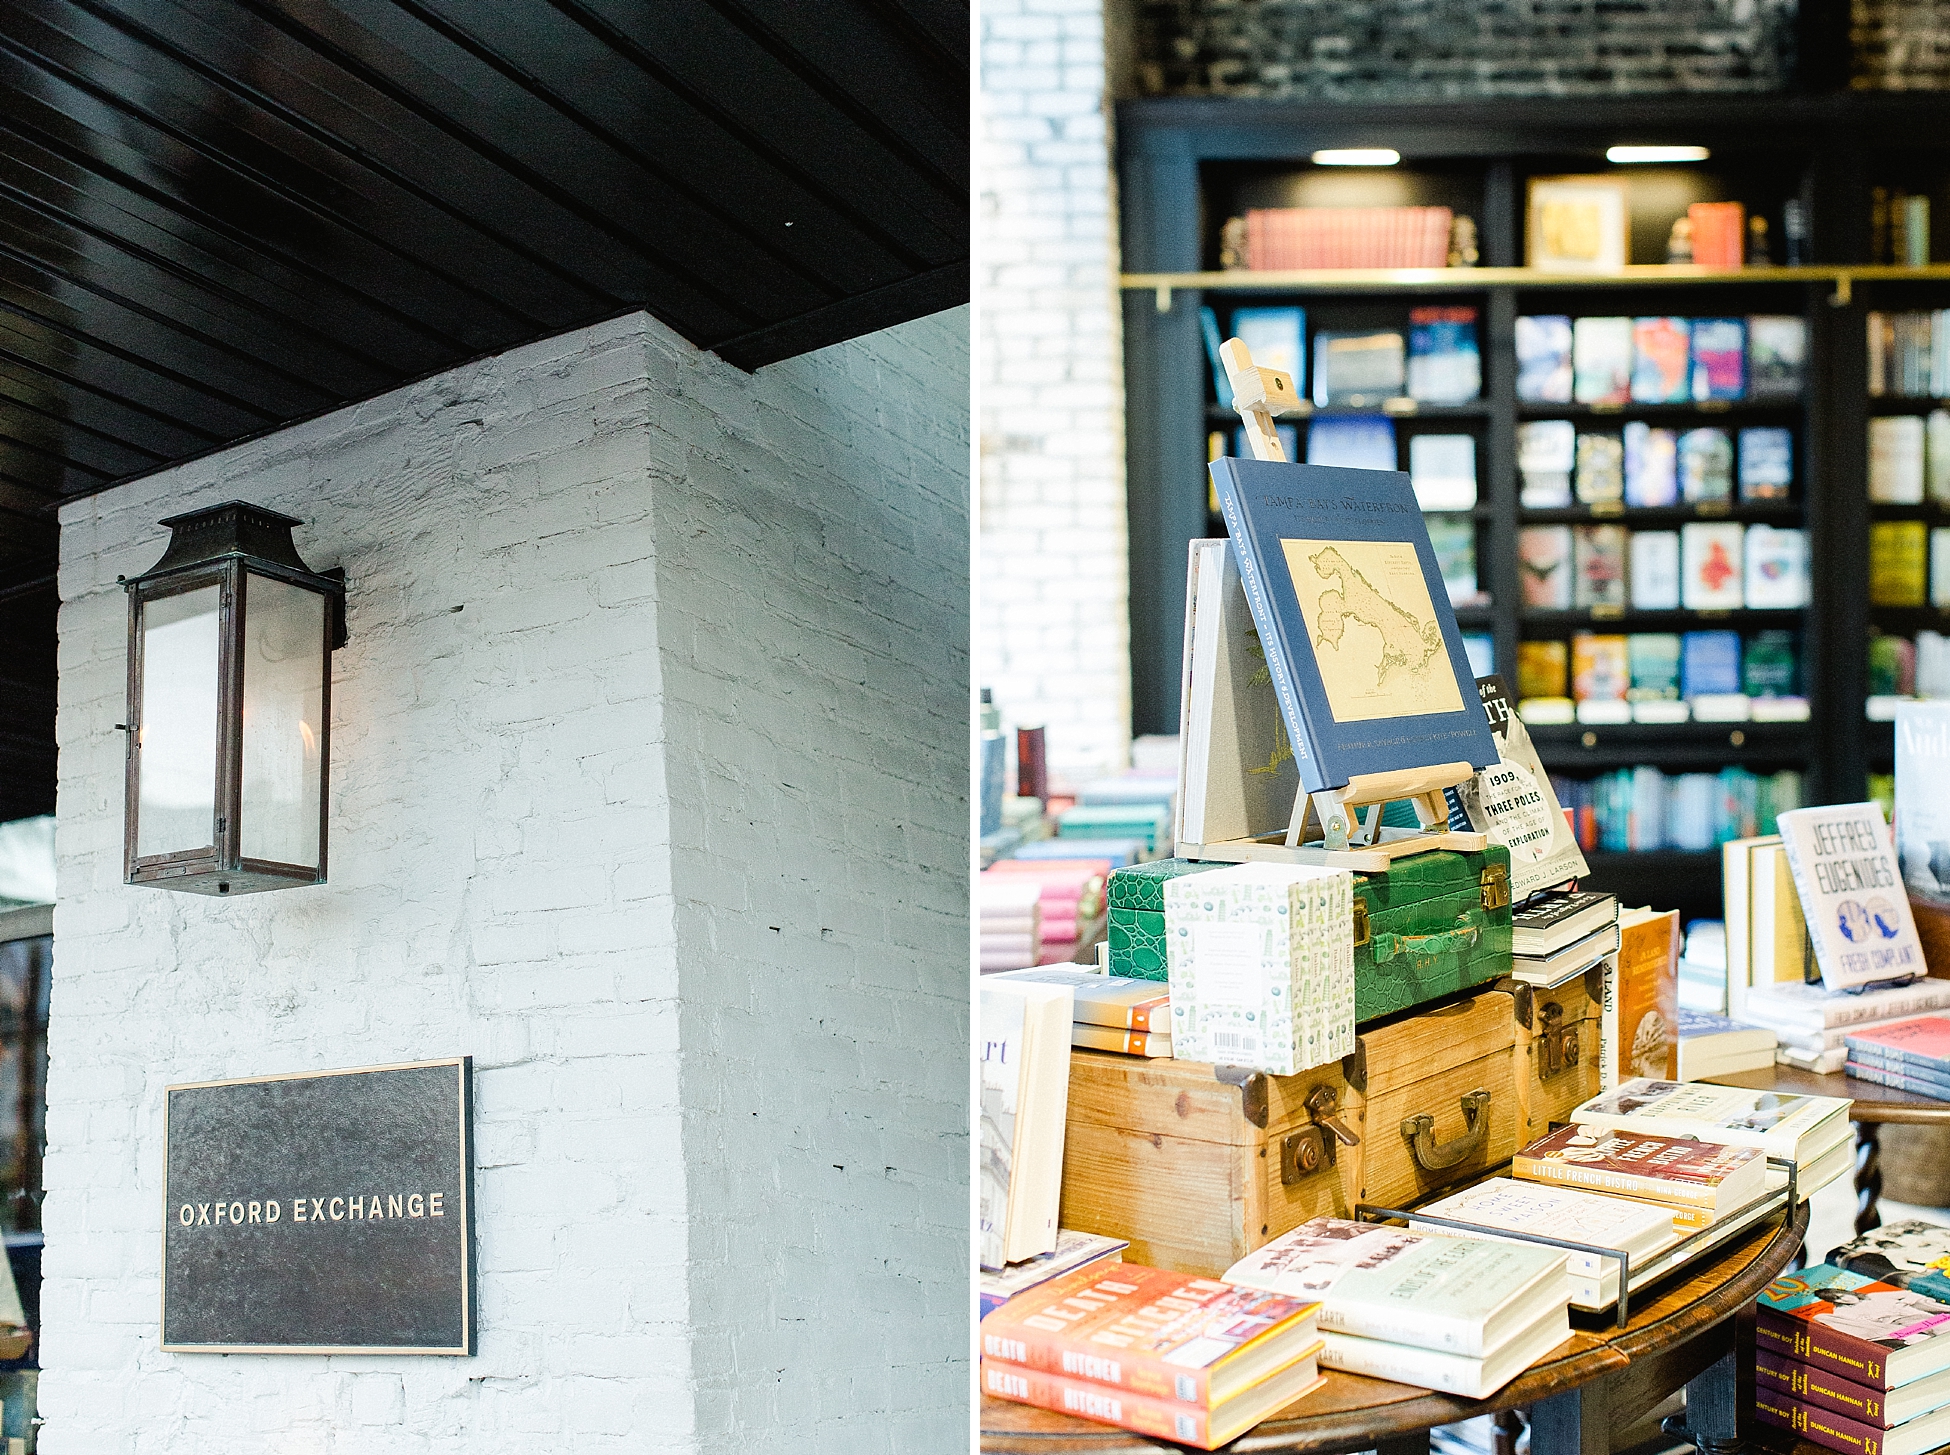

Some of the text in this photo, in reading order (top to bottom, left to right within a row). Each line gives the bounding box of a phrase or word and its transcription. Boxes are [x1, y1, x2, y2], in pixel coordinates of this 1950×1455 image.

[1225, 491, 1238, 528] TAMPA
[1244, 557, 1268, 622] WATERFRONT
[1265, 632, 1274, 646] ITS
[1269, 647, 1287, 685] HISTORY
[1479, 683, 1497, 697] of the
[1282, 691, 1309, 760] DEVELOPMENT
[1489, 771, 1520, 787] 1909,
[1485, 799, 1514, 818] THREE
[1495, 806, 1544, 827] AND THE CLIMAX
[1502, 827, 1510, 836] OF
[1511, 823, 1524, 832] THE
[1525, 819, 1537, 828] AGE
[1508, 827, 1550, 848] EXPLORATION
[1812, 819, 1878, 856] JEFFREY
[1510, 874, 1541, 891] EDWARD
[1549, 859, 1579, 876] LARSON
[1814, 855, 1895, 895] EUGENIDES
[1840, 952, 1871, 974] FRESH
[1603, 962, 1613, 1013] A LAND
[1600, 1038, 1608, 1069] Patrick
[1616, 1140, 1667, 1162] FRENCH
[1532, 1163, 1563, 1180] LITTLE
[1566, 1169, 1602, 1187] FRENCH
[1605, 1174, 1639, 1192] BISTRO
[1656, 1186, 1672, 1195] NINA
[1674, 1188, 1698, 1199] GEORGE
[179, 1192, 446, 1227] OXFORD EXCHANGE
[1471, 1192, 1514, 1211] HOME
[1489, 1195, 1537, 1217] SWEET
[1508, 1196, 1563, 1223] MAISON
[1416, 1225, 1439, 1234] HOME
[1022, 1279, 1140, 1332] DEATH
[1318, 1309, 1346, 1326] EARTH
[984, 1333, 1027, 1363] DEATH
[1317, 1349, 1345, 1366] EARTH
[1756, 1327, 1865, 1370] CENTURY BOY DUNCAN HANNAH
[987, 1369, 1029, 1399] DEATH
[1756, 1365, 1863, 1408] ENTURY BOY DUNCAN HANNAH
[1778, 1410, 1790, 1419] BOY
[1810, 1421, 1835, 1436] DUNCAN
[1835, 1430, 1862, 1446] HANNAH
